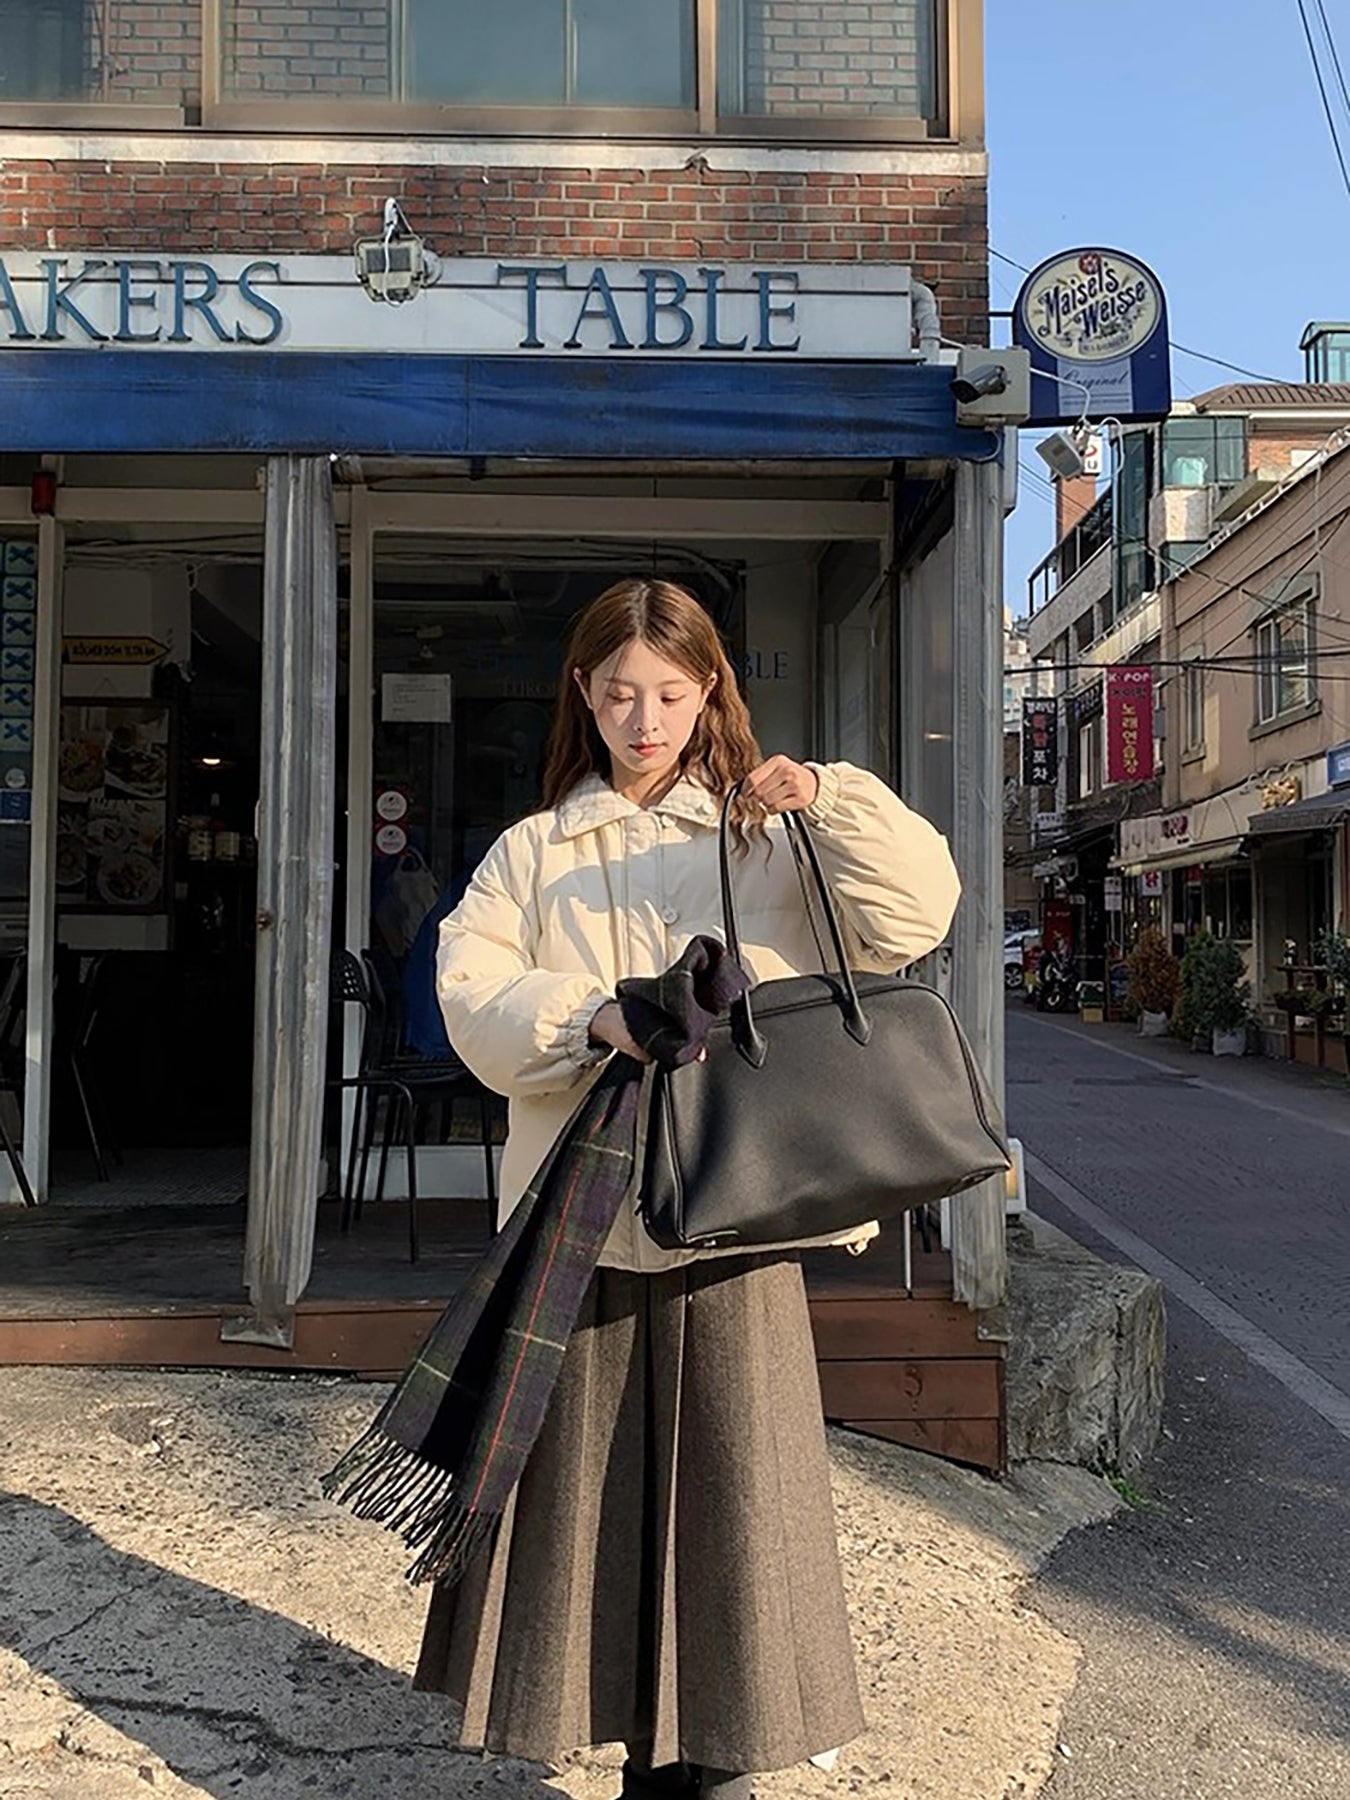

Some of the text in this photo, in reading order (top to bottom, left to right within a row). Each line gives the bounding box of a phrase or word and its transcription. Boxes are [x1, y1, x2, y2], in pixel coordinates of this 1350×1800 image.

[497, 263, 801, 352] TABLE
[1037, 261, 1119, 338] Maisel's
[1073, 280, 1146, 338] Weisse
[1063, 368, 1129, 390] Original
